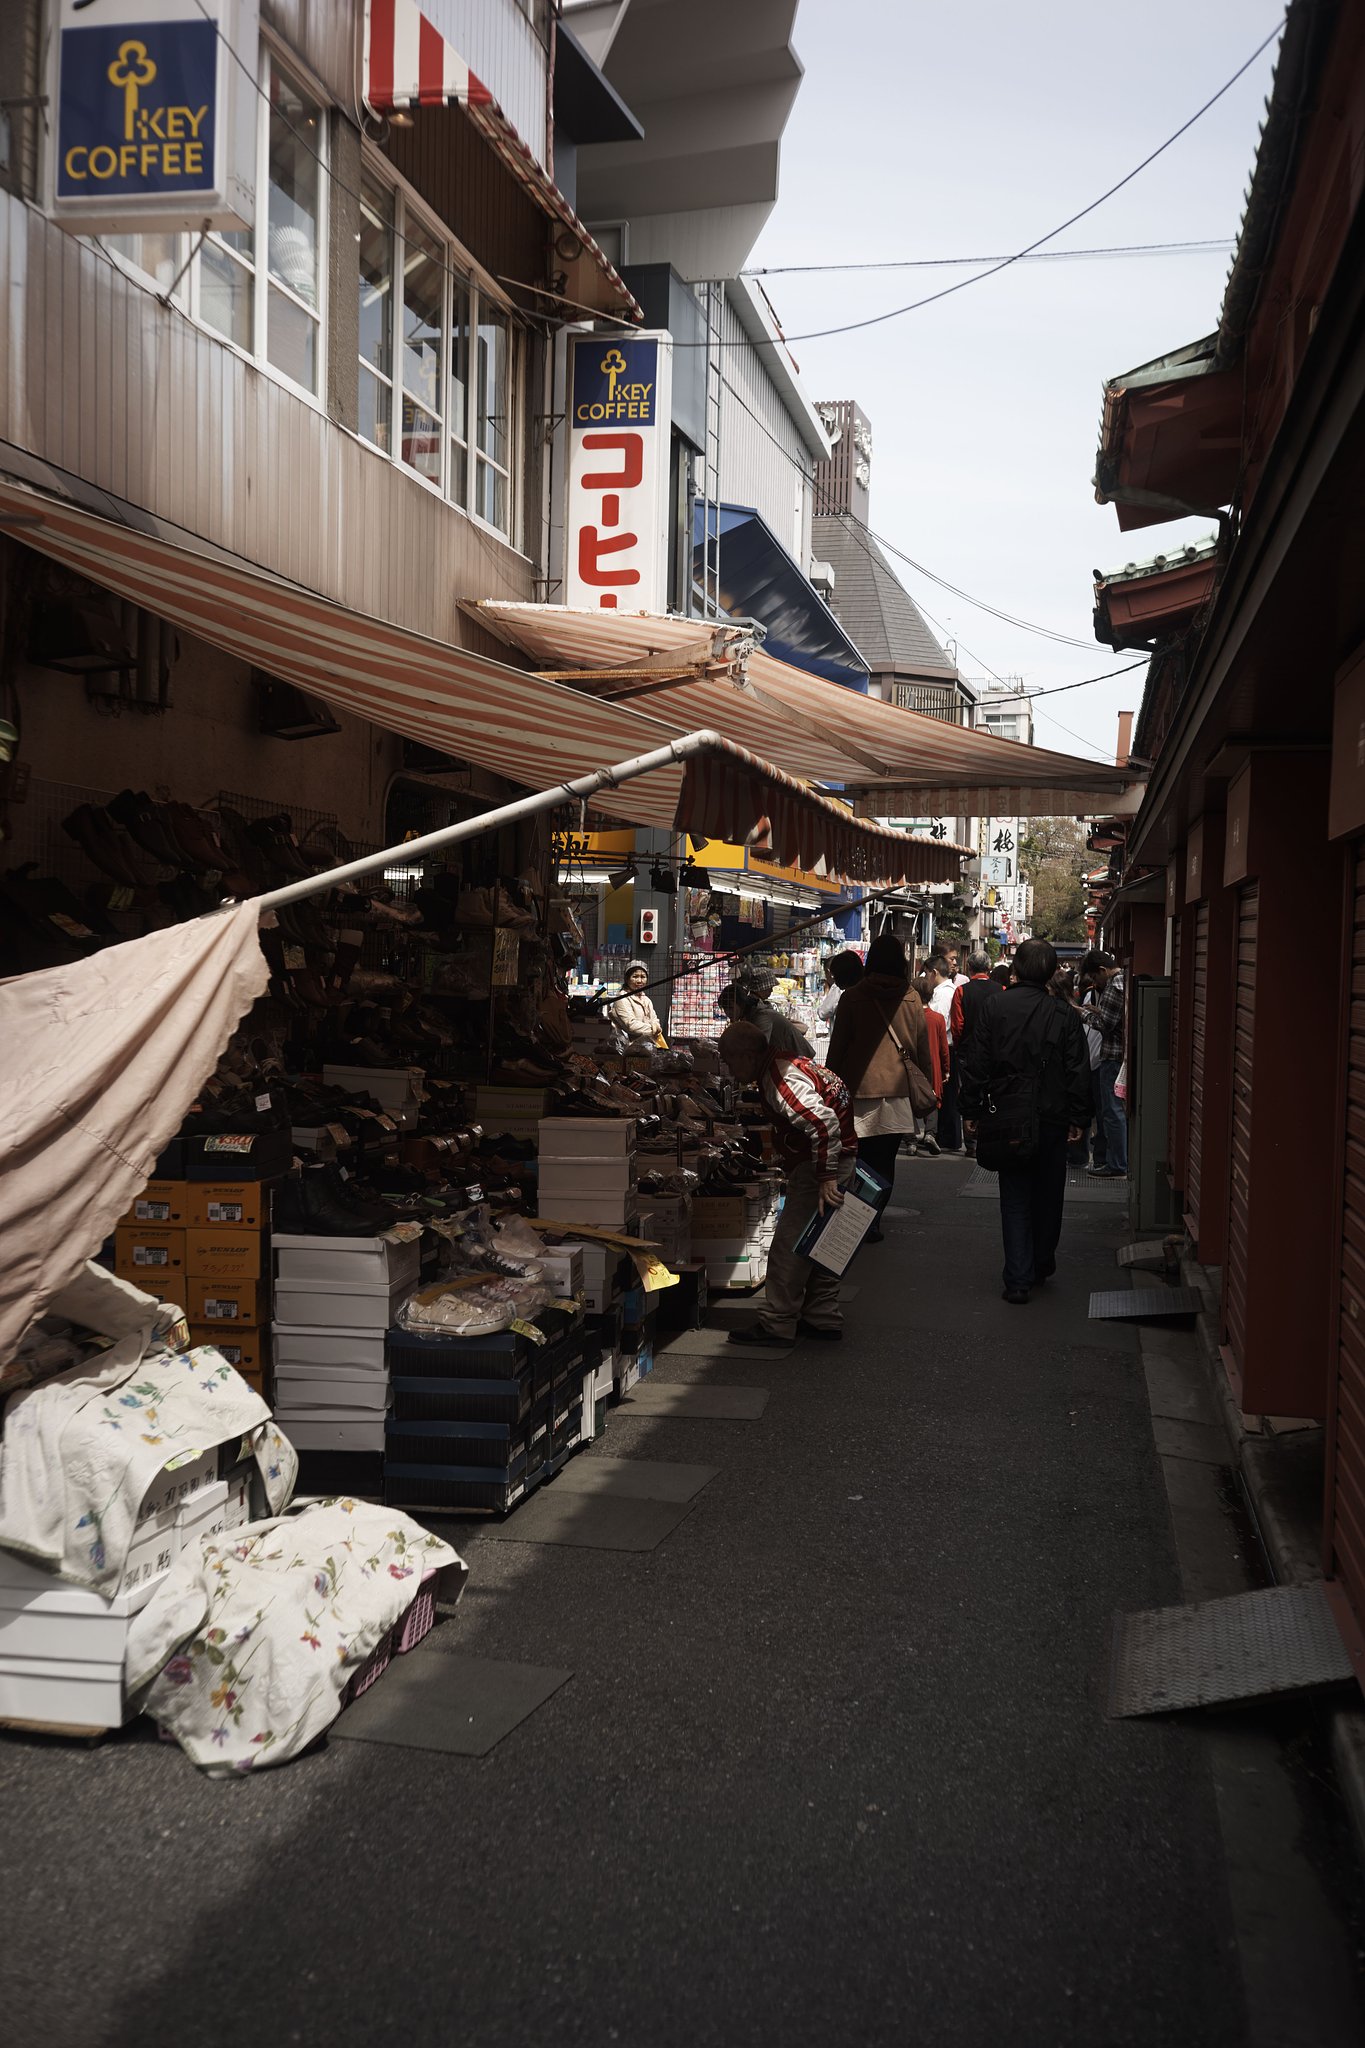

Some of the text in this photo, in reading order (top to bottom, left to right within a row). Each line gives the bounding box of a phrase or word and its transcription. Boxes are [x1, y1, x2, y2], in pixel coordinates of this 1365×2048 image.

[137, 105, 208, 140] KEY
[64, 141, 204, 180] COFFEE
[614, 383, 653, 401] KEY
[577, 402, 650, 420] COFFEE
